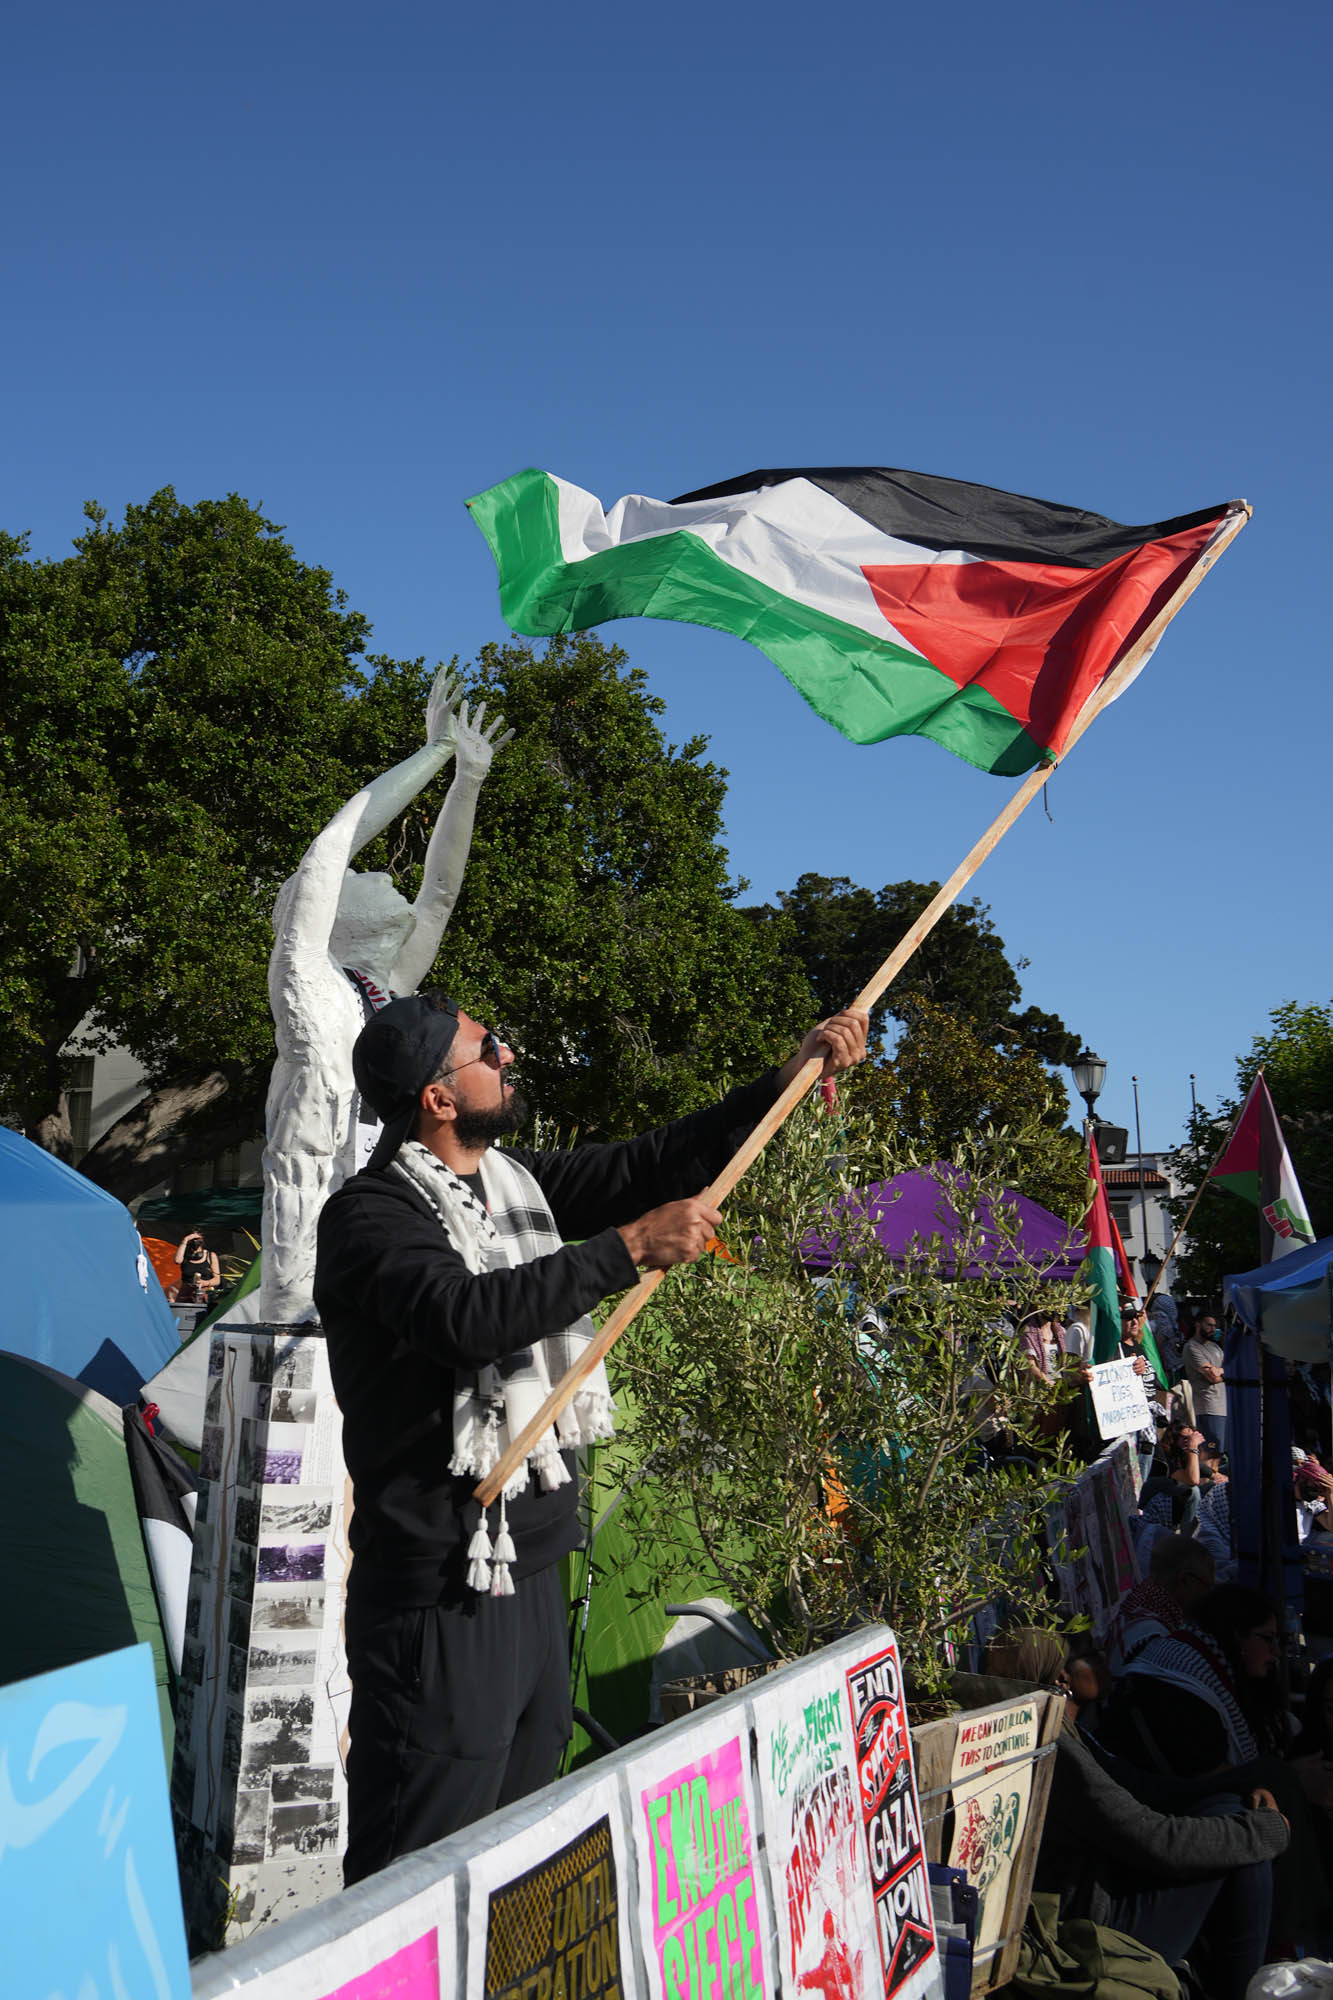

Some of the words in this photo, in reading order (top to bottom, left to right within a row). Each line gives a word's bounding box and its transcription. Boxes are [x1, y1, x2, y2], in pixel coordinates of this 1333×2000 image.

[850, 1660, 899, 1727] END
[961, 1726, 977, 1745] WE
[861, 1706, 906, 1808] SIEGE
[960, 1748, 982, 1768] THIS
[982, 1745, 993, 1760] TO
[993, 1732, 1031, 1758] CONTINUE
[648, 1776, 717, 1928] END
[712, 1796, 749, 1883] THE
[868, 1791, 920, 1882] GAZA
[553, 1858, 616, 1951] UNTIL
[663, 1876, 765, 2000] SIEGE
[877, 1864, 931, 1970] NOW
